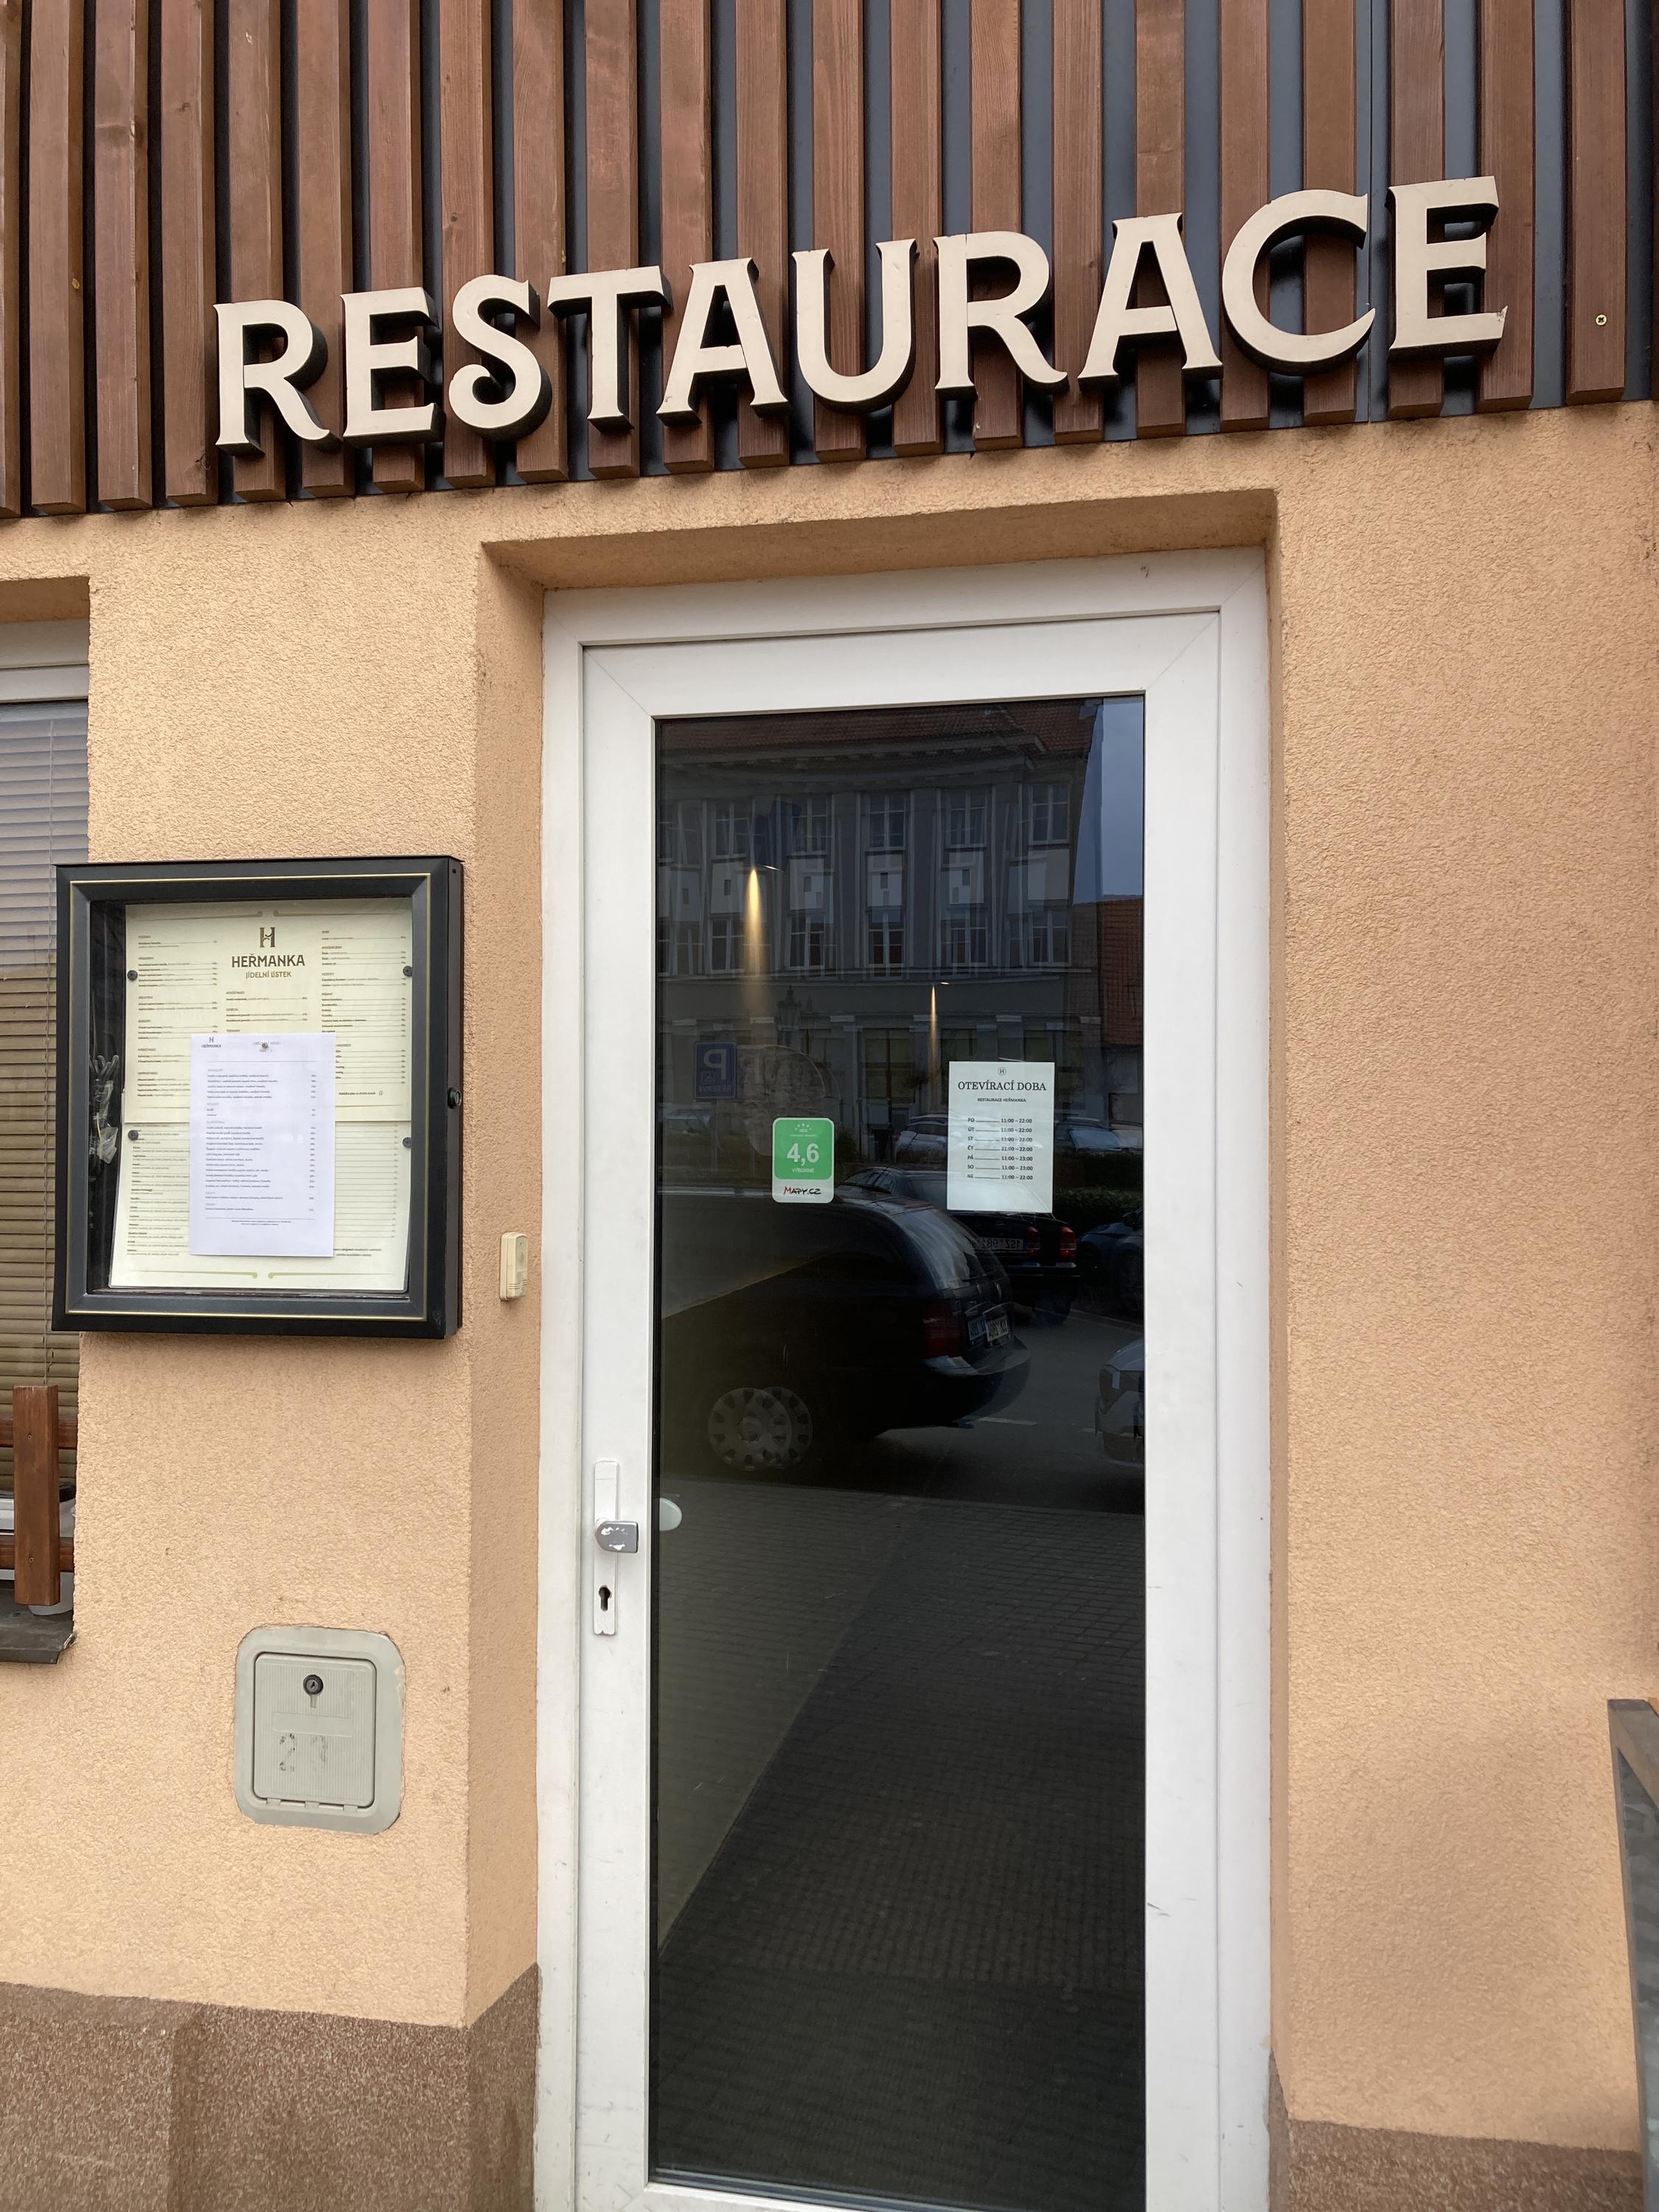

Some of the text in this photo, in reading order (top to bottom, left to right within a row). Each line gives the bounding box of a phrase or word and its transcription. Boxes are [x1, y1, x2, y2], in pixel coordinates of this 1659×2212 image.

[215, 175, 1508, 451] RESTAURACE
[232, 953, 305, 967] HEŘMANKA
[246, 970, 270, 978] JÍDELNÍ
[958, 1079, 1047, 1091] OTEVÍRACÍ DOBA
[787, 1143, 819, 1166] 4,6
